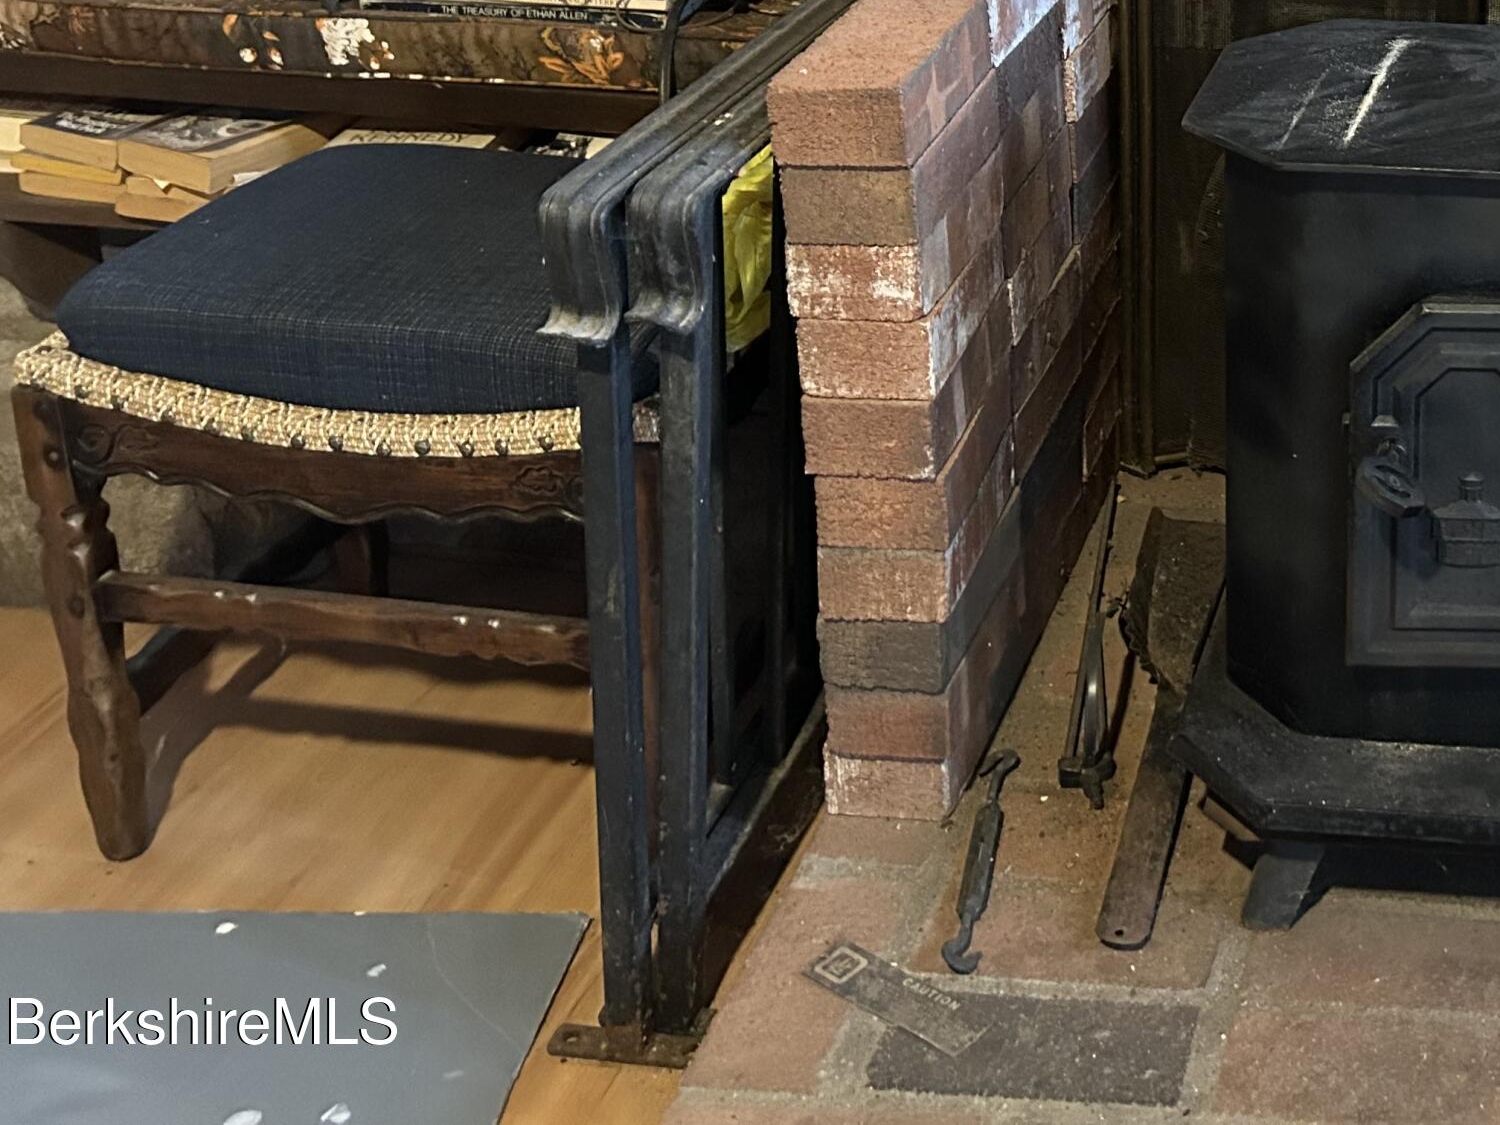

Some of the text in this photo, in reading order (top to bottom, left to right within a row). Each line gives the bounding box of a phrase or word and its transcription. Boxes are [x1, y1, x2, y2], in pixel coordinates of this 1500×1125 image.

[440, 5, 588, 20] THE TREASURY OF ETHAN ALLEN
[902, 977, 961, 1011] CAUTION
